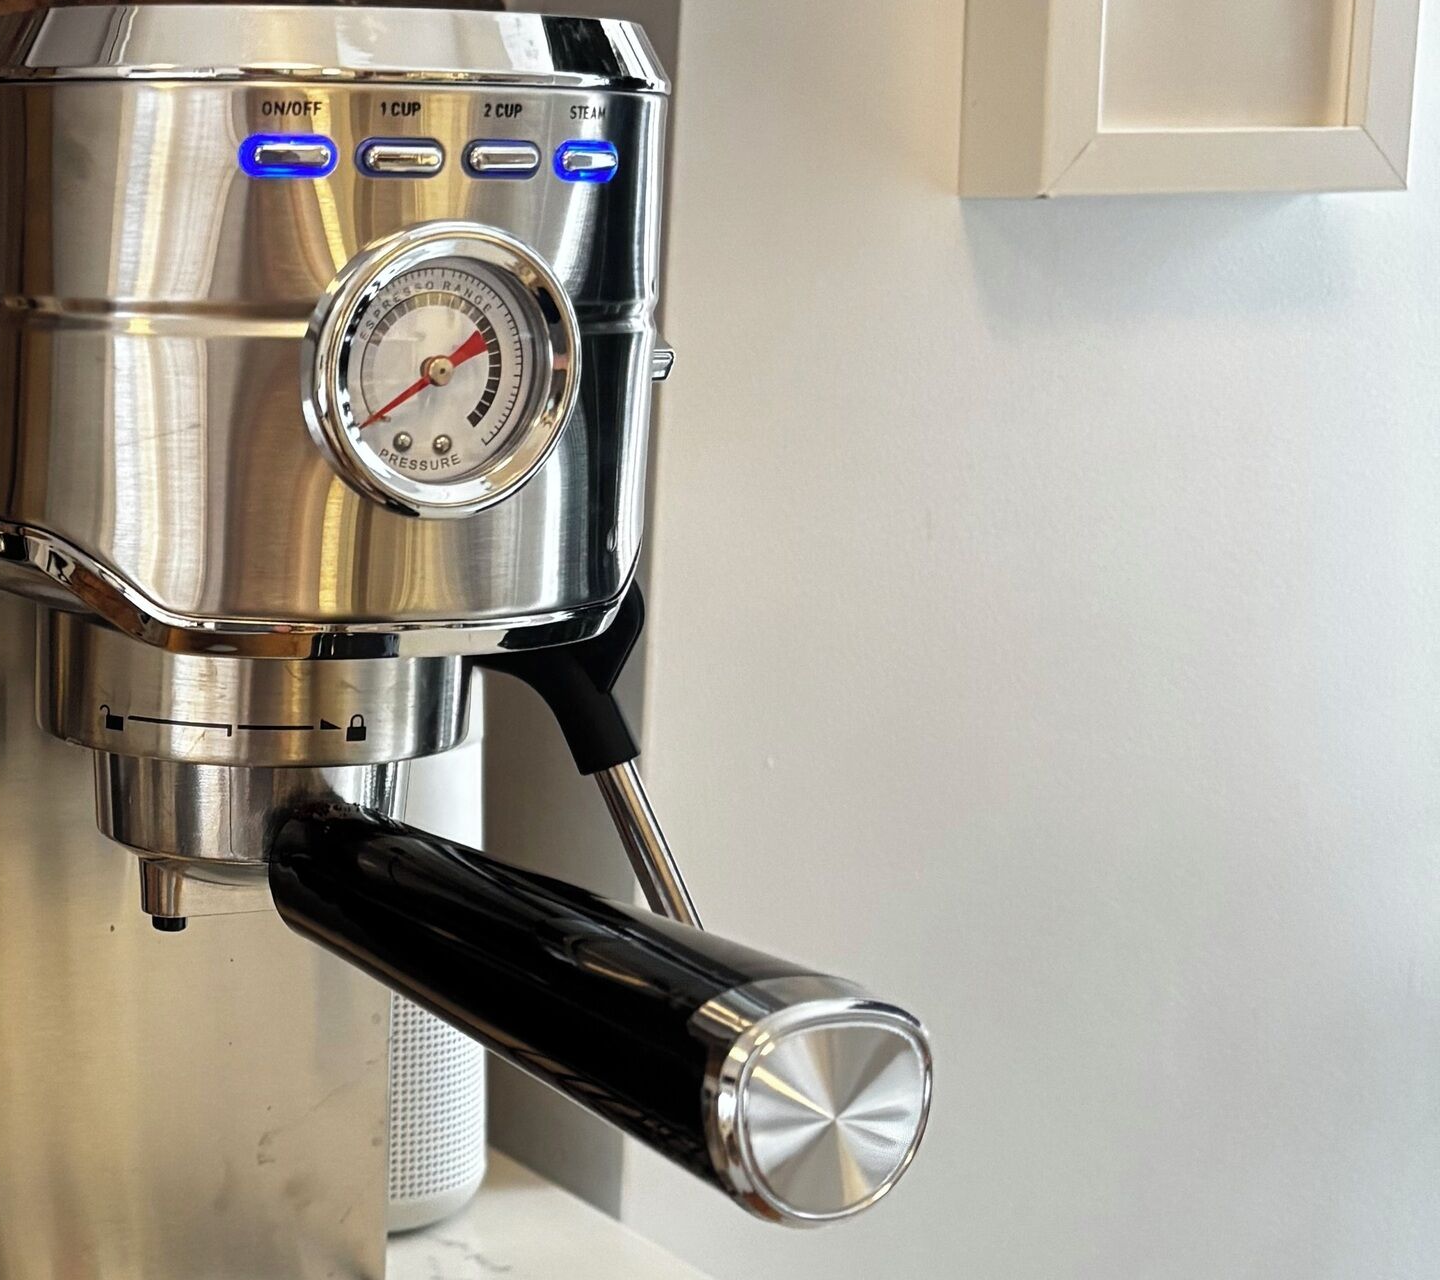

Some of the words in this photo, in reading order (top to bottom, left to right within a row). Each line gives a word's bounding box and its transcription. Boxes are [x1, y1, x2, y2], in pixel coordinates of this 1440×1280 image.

[261, 100, 323, 117] ON/OFF
[380, 103, 387, 117] 1
[390, 103, 422, 117] CUP
[483, 103, 493, 118] 2
[495, 103, 524, 118] CUP
[569, 104, 607, 121] STEAM
[360, 280, 435, 342] ESPRESSO
[442, 280, 493, 314] RANGE
[378, 448, 462, 472] PRESSURE
